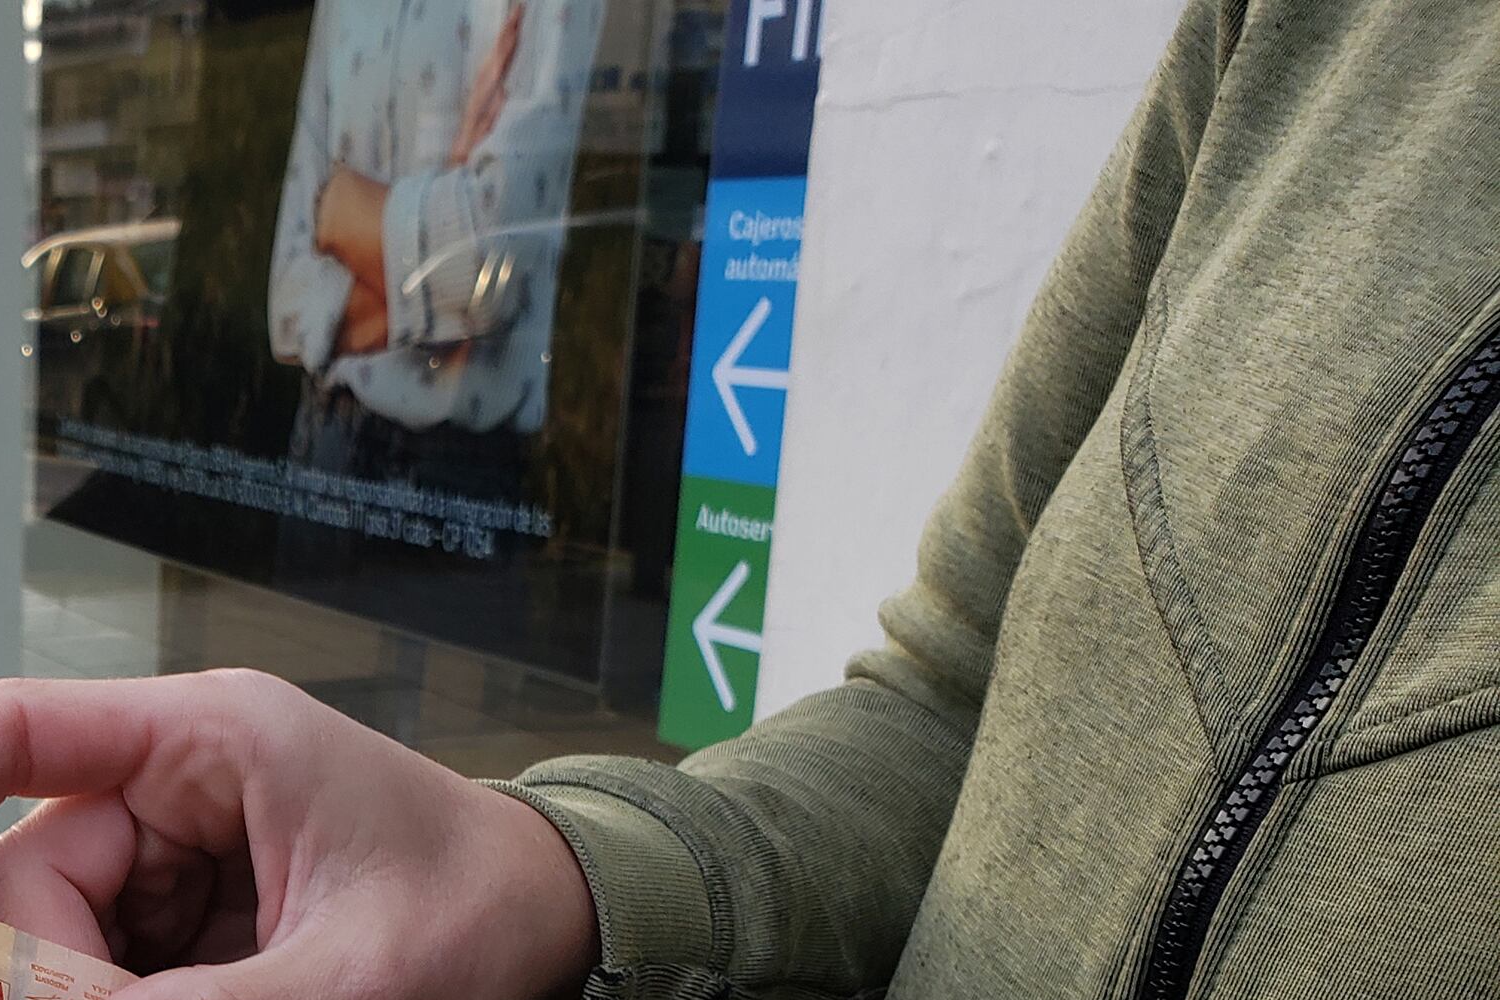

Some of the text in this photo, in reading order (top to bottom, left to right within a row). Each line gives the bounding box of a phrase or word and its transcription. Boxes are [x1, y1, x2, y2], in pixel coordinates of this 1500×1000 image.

[744, 0, 824, 66] FI
[729, 209, 803, 247] Cajeros
[696, 503, 772, 542] Autoser
